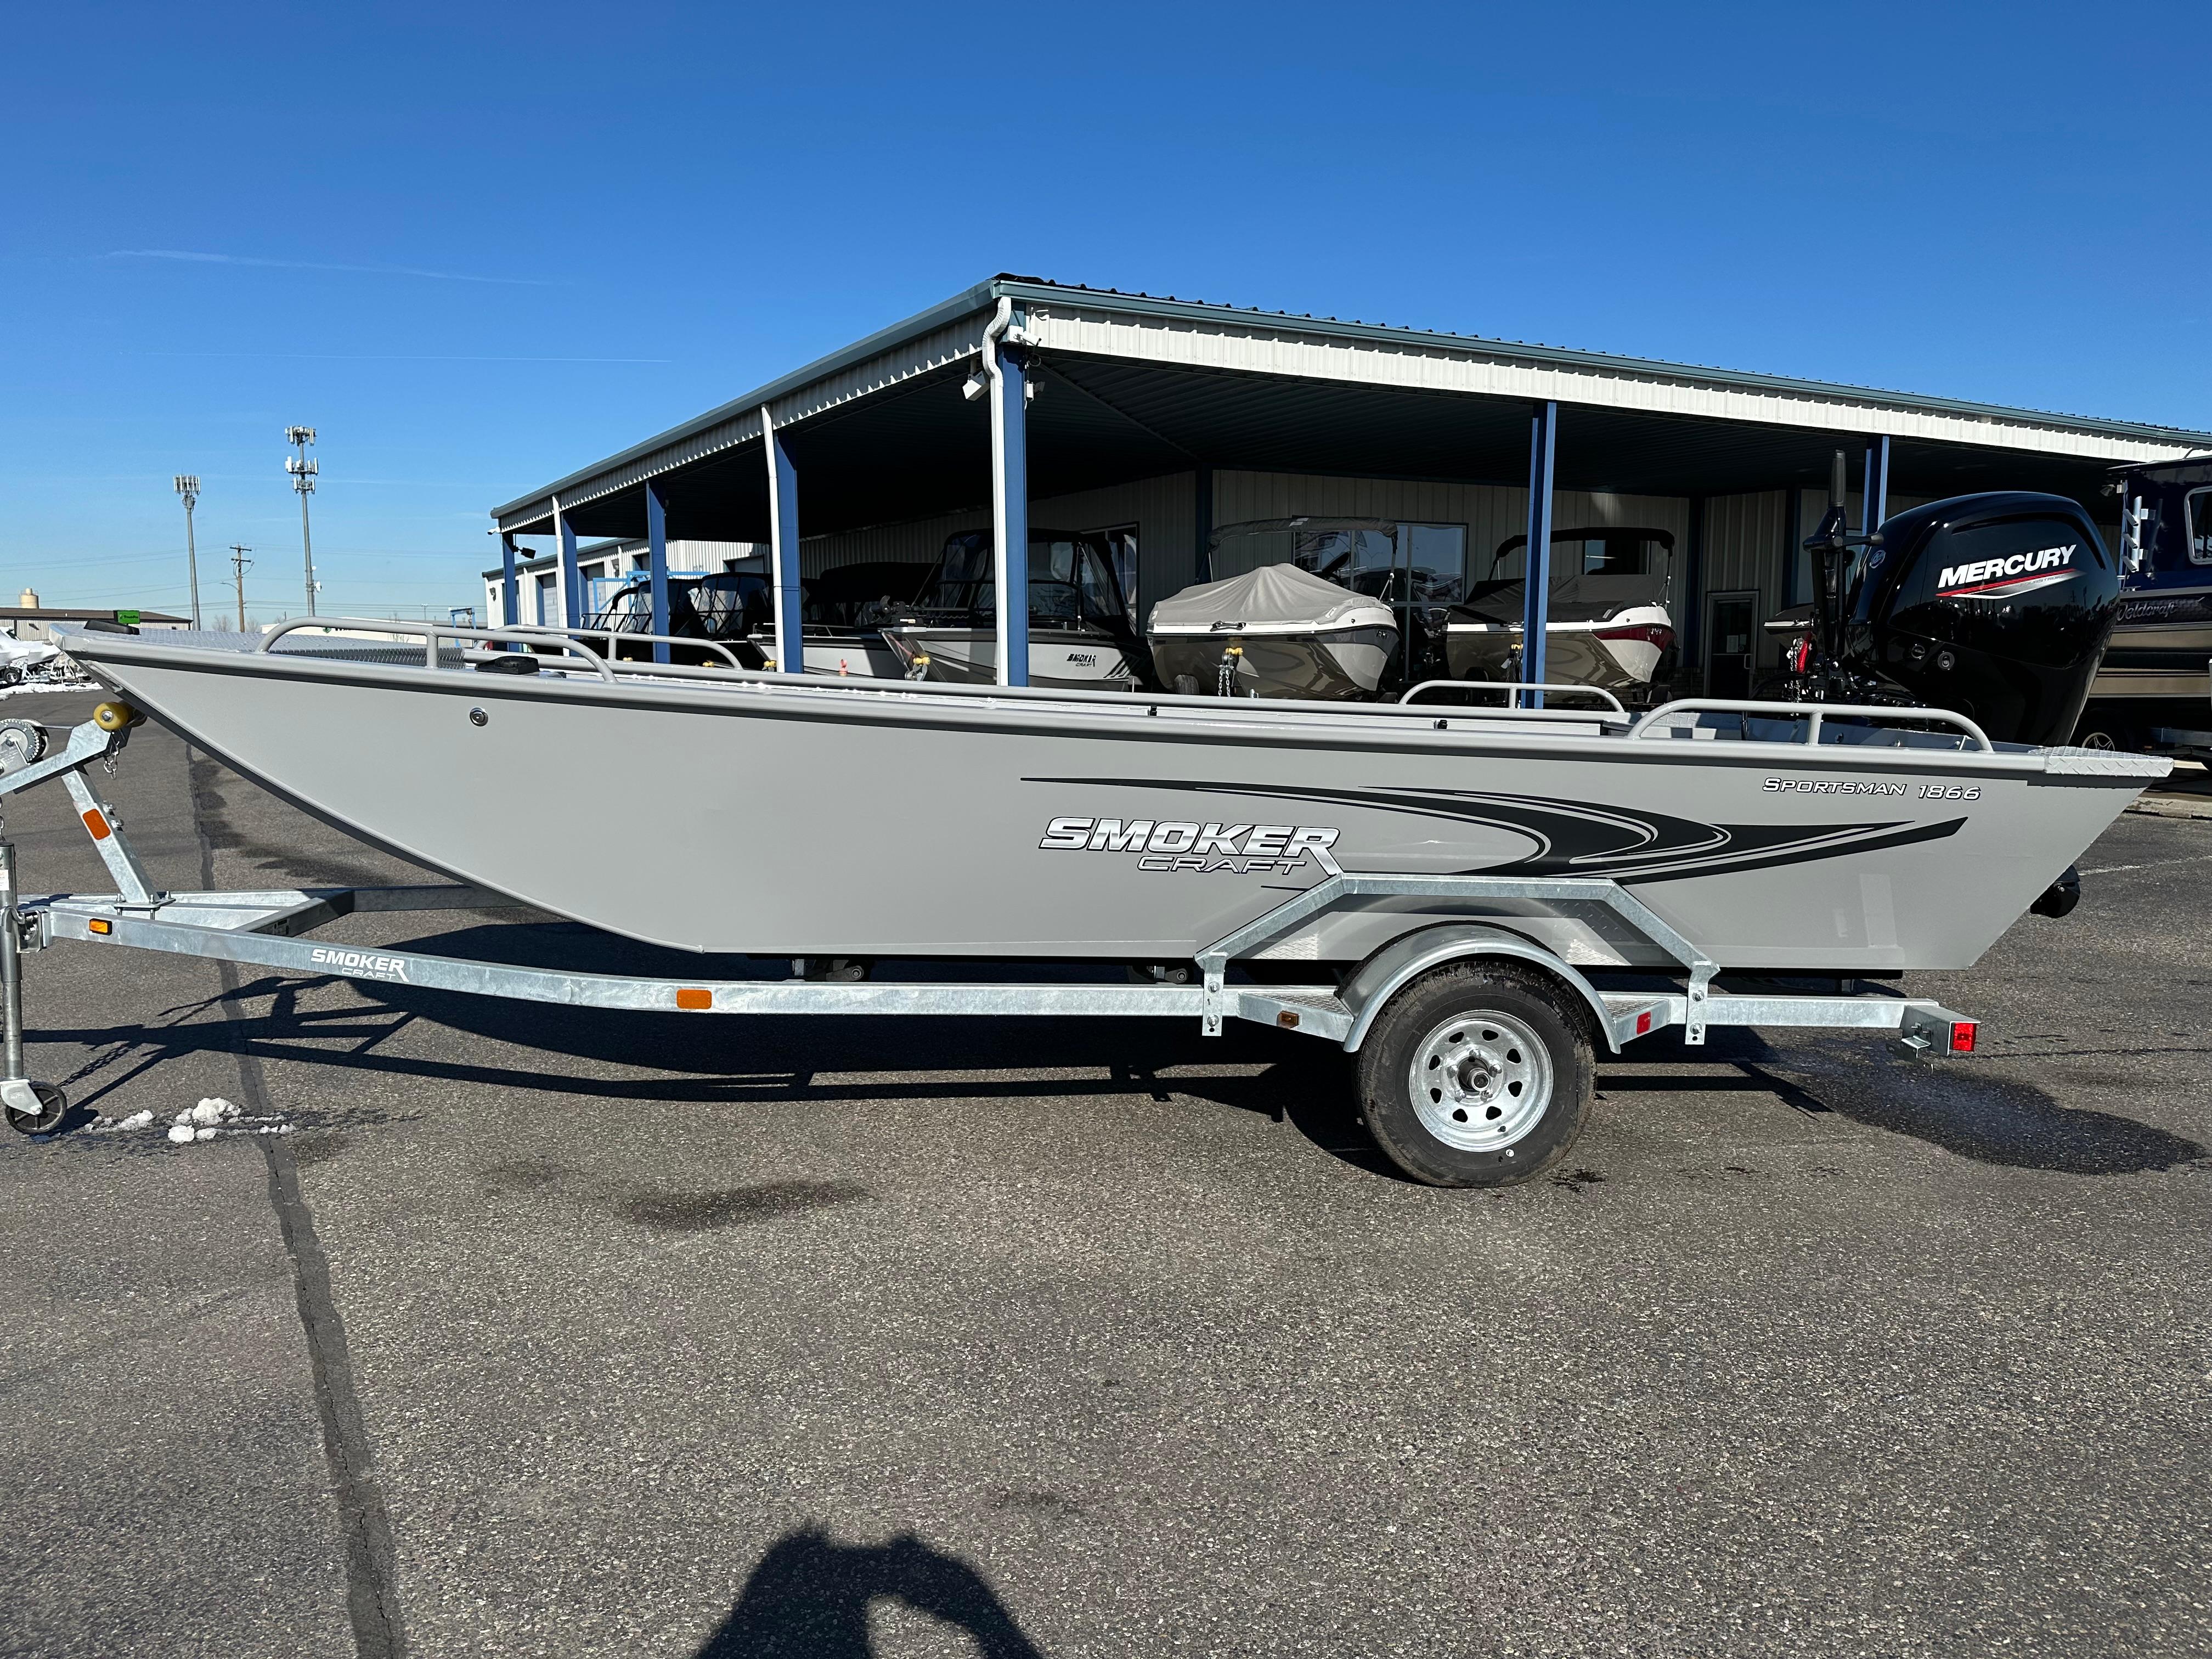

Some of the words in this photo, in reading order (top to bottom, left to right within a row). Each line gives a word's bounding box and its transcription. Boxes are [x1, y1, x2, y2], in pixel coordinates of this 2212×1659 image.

[1937, 544, 2076, 588] MERCURY
[1762, 777, 1907, 795] SPORTSMAN
[1918, 785, 1982, 801] 1866
[1039, 816, 1343, 876] SMOKER
[1137, 856, 1307, 874] CRAFT
[311, 949, 409, 983] SMOKER
[341, 967, 396, 980] CRAFT
